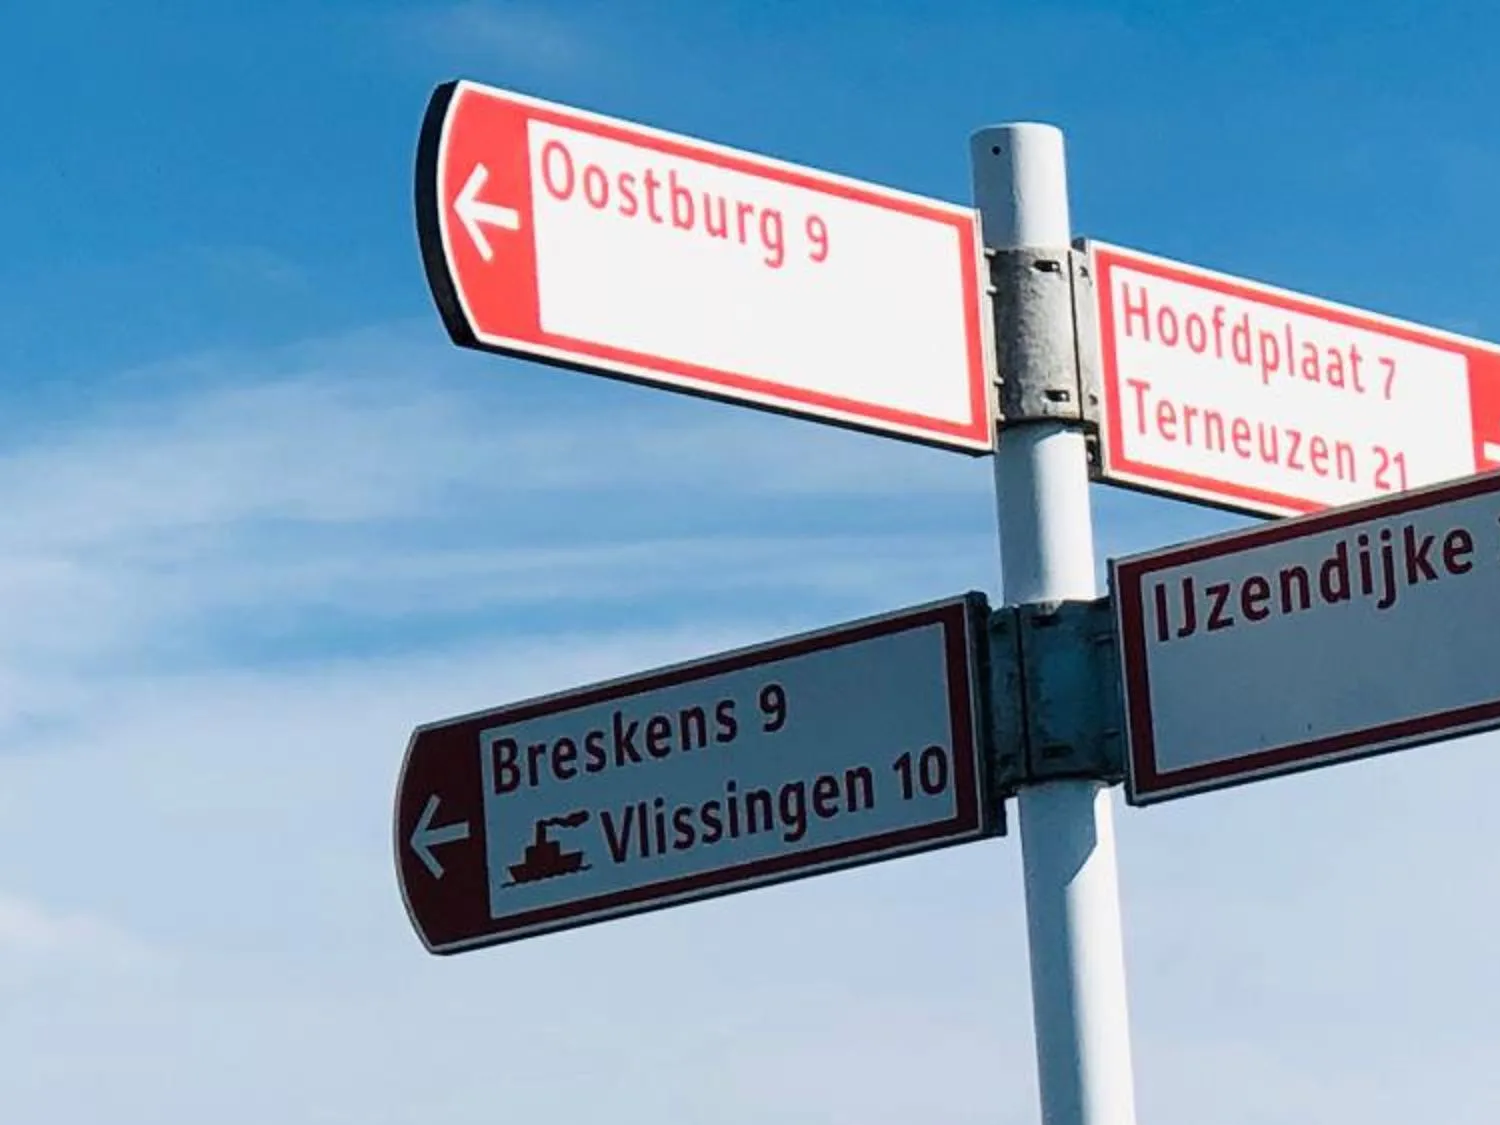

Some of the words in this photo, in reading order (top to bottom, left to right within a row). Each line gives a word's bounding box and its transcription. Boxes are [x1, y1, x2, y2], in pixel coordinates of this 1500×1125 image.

[541, 140, 786, 269] Oostburg
[804, 215, 830, 262] 9
[1122, 282, 1365, 394] Hoofdplaat
[1378, 357, 1397, 400] 7
[1126, 378, 1357, 482] Terneuzen
[1373, 446, 1407, 492] 21
[1154, 526, 1474, 642] IJzendijke
[492, 698, 738, 795] Breskens
[759, 683, 787, 733] 9
[600, 765, 875, 864] Vlissingen
[893, 745, 948, 800] 10
